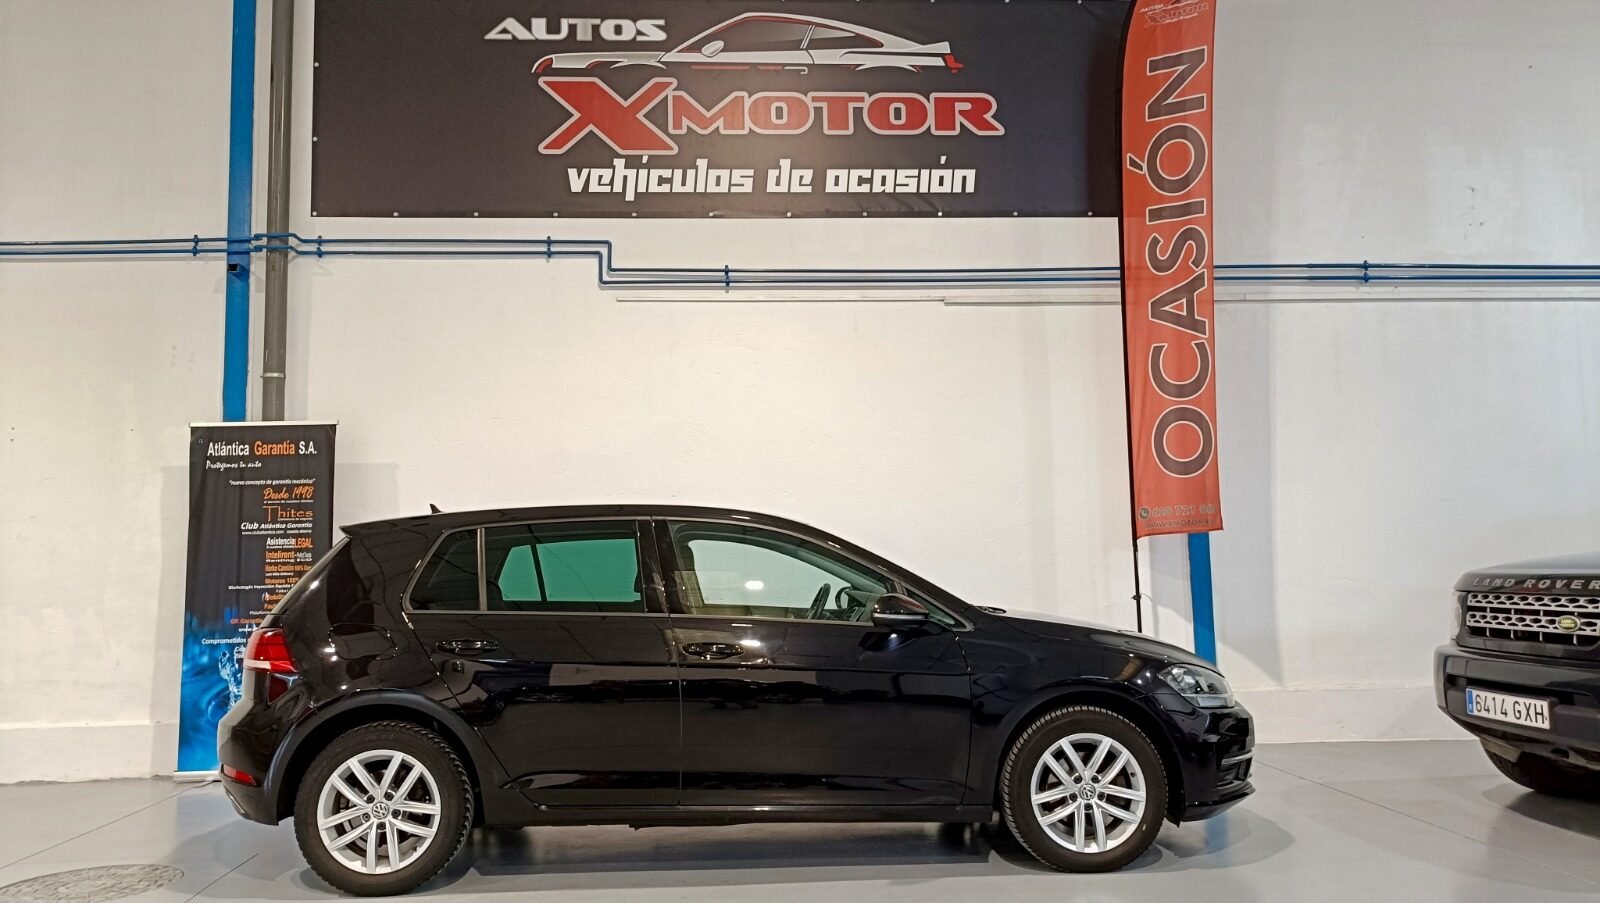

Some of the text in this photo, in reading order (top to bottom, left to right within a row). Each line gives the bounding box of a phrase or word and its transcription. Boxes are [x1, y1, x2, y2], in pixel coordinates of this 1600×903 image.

[484, 17, 668, 42] AUTOS
[538, 76, 1006, 155] XMOTOR
[567, 155, 976, 201] vehículos de ocasión
[1127, 45, 1215, 478] OCASIÓN
[207, 440, 317, 456] Atlántica Garantía S.A.
[263, 486, 314, 500] Desde 1998
[262, 505, 313, 522] Thites
[241, 522, 259, 530] Club
[1472, 577, 1600, 590] LAND ROVER
[201, 637, 247, 645] Comprometidos
[1475, 694, 1545, 725] 6414 GXH
